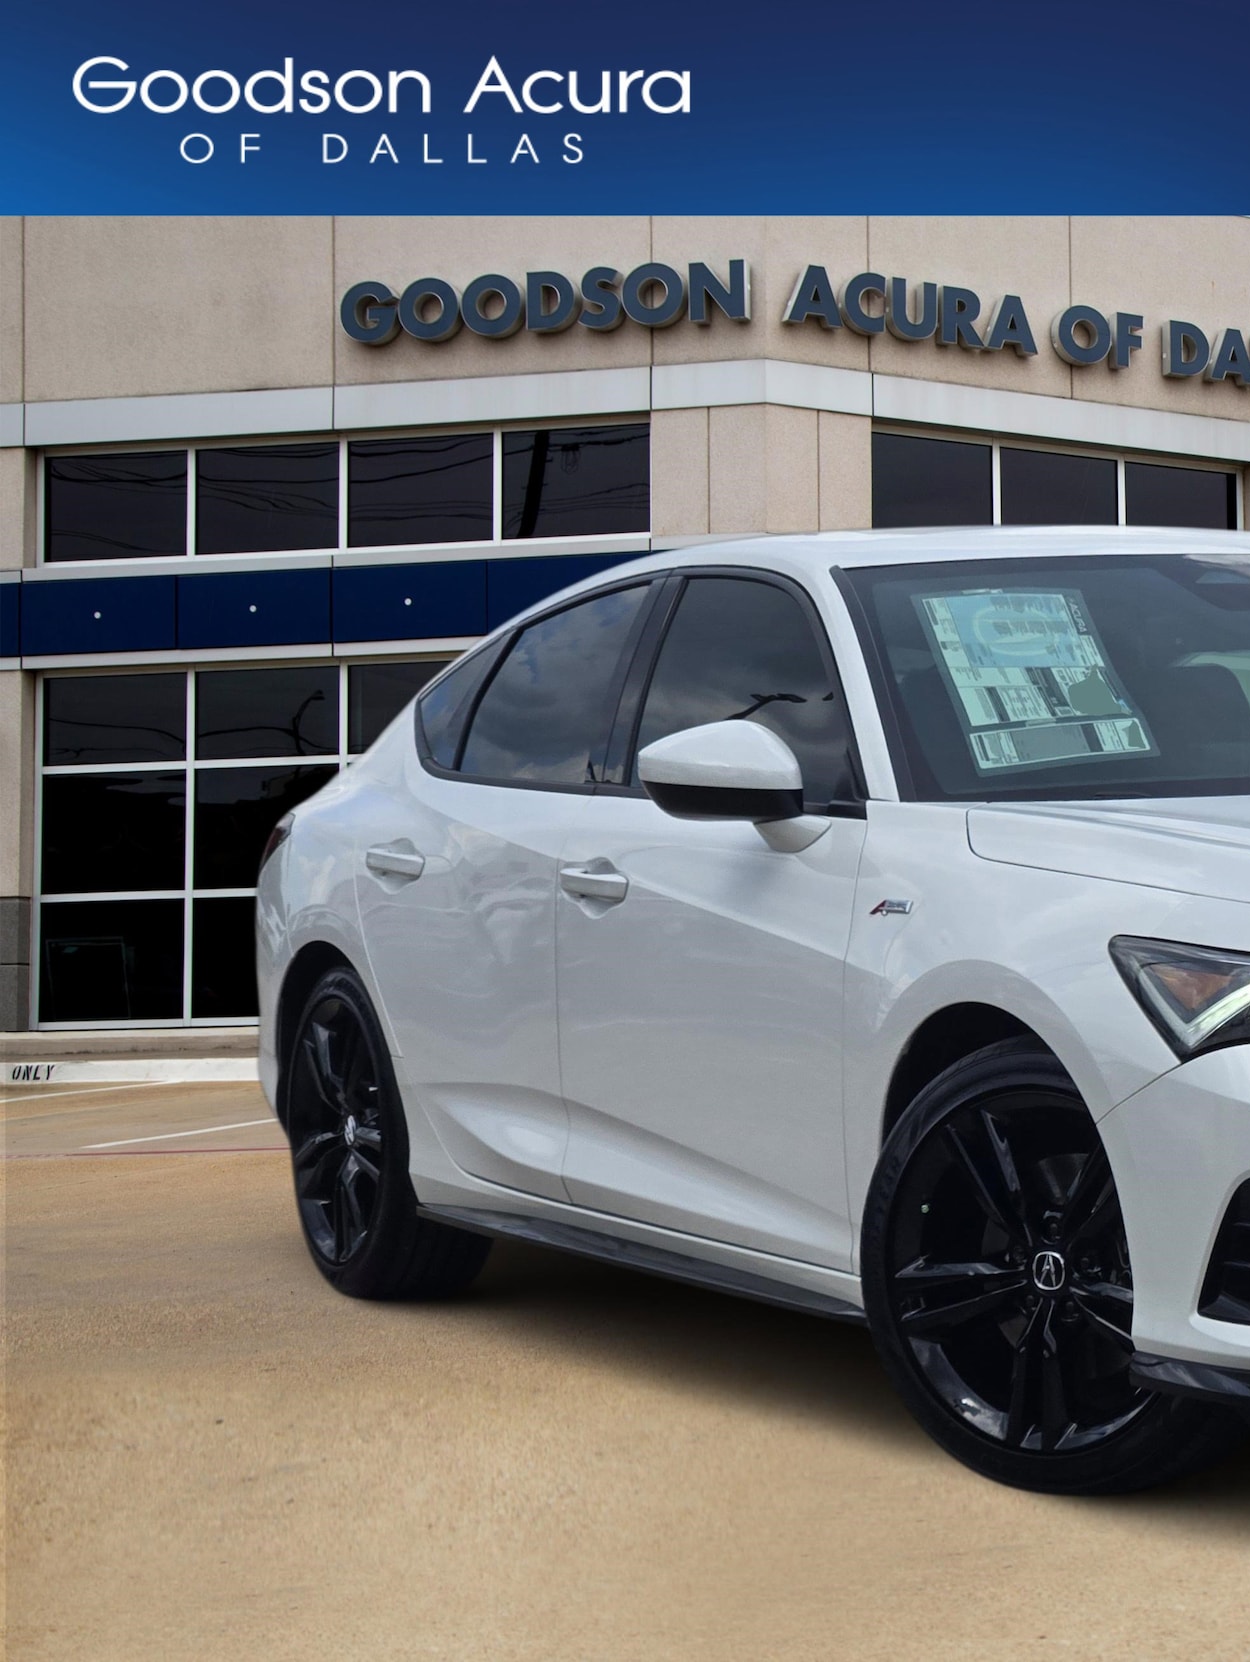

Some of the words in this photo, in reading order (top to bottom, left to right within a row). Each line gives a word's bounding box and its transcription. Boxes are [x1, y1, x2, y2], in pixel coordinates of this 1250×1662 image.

[340, 258, 751, 346] GOODSON
[783, 264, 1038, 357] ACURA
[1052, 305, 1144, 370] OF
[12, 1065, 55, 1081] ONLY
